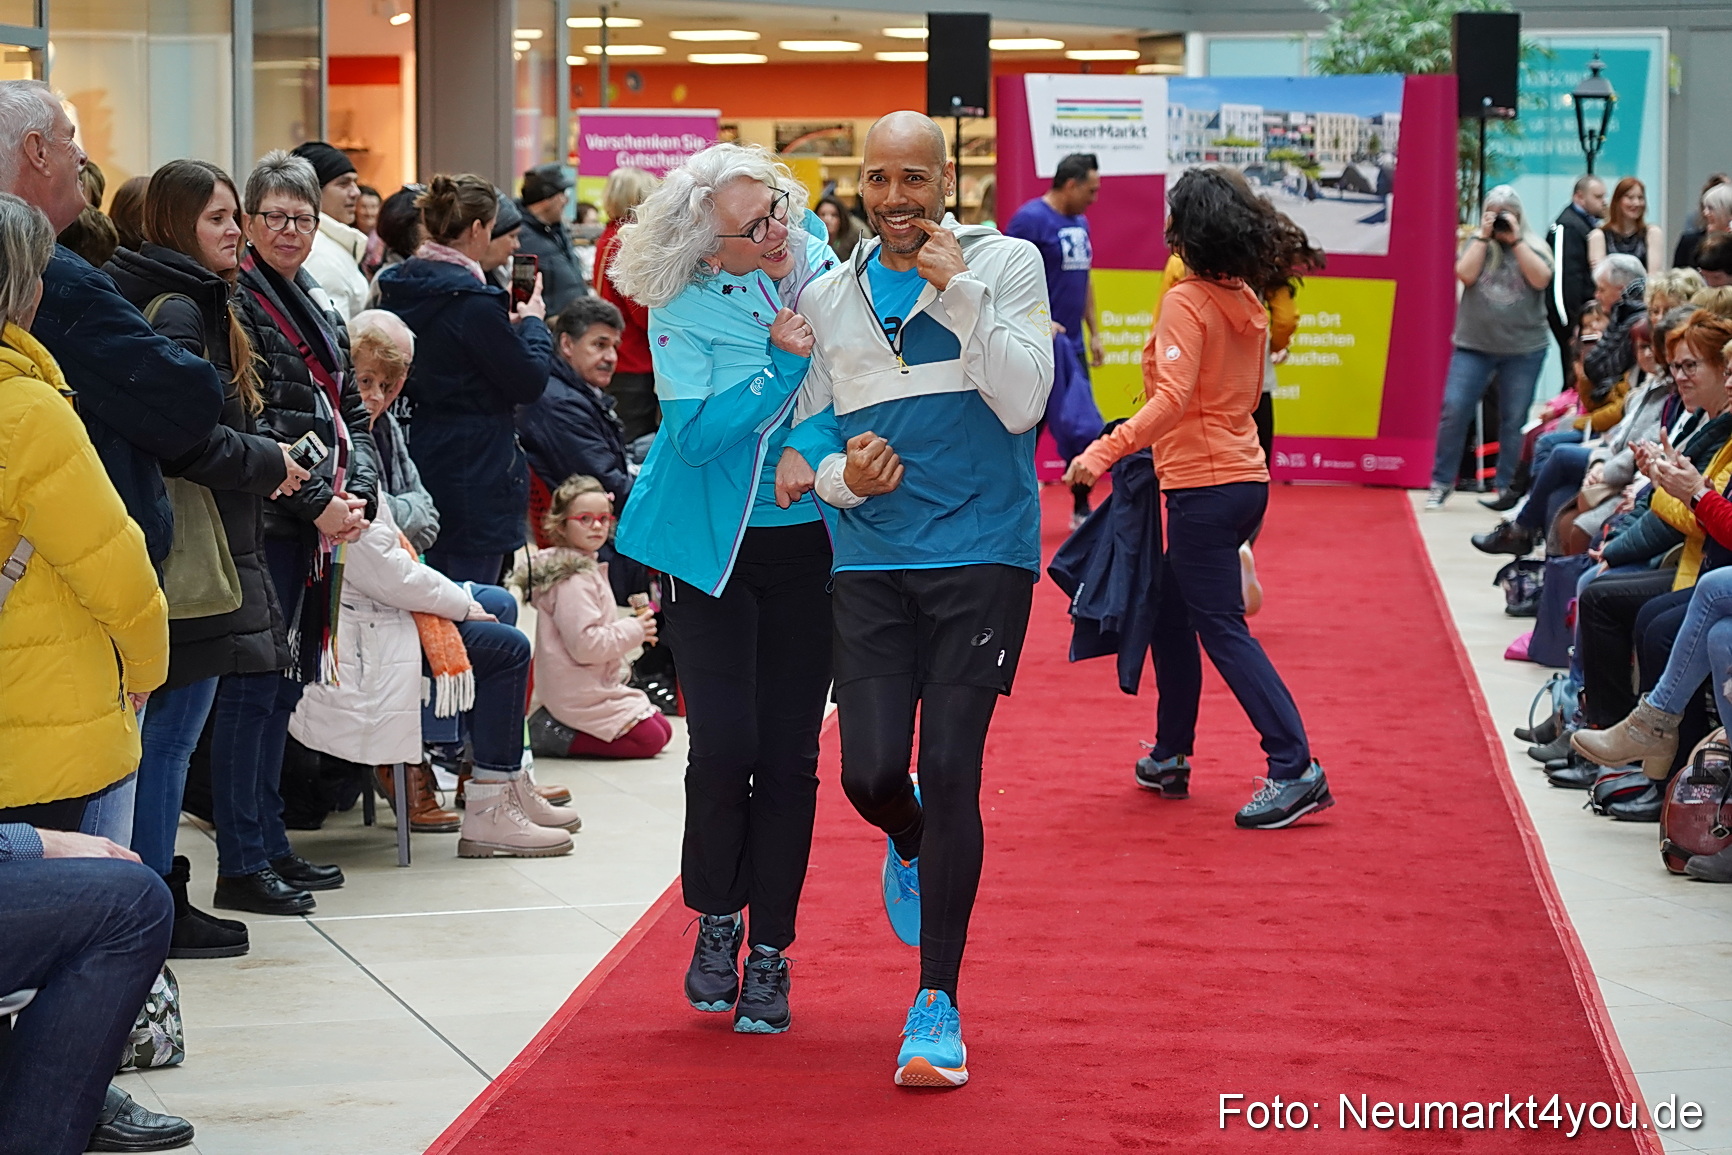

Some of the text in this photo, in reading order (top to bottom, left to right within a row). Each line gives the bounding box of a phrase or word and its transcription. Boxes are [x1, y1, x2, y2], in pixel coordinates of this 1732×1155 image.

[1050, 122, 1148, 138] NeuerMarkt
[584, 133, 706, 151] Verschenken Sie
[1101, 310, 1122, 327] Du
[1317, 311, 1341, 328] Ort
[1298, 331, 1354, 347] machen
